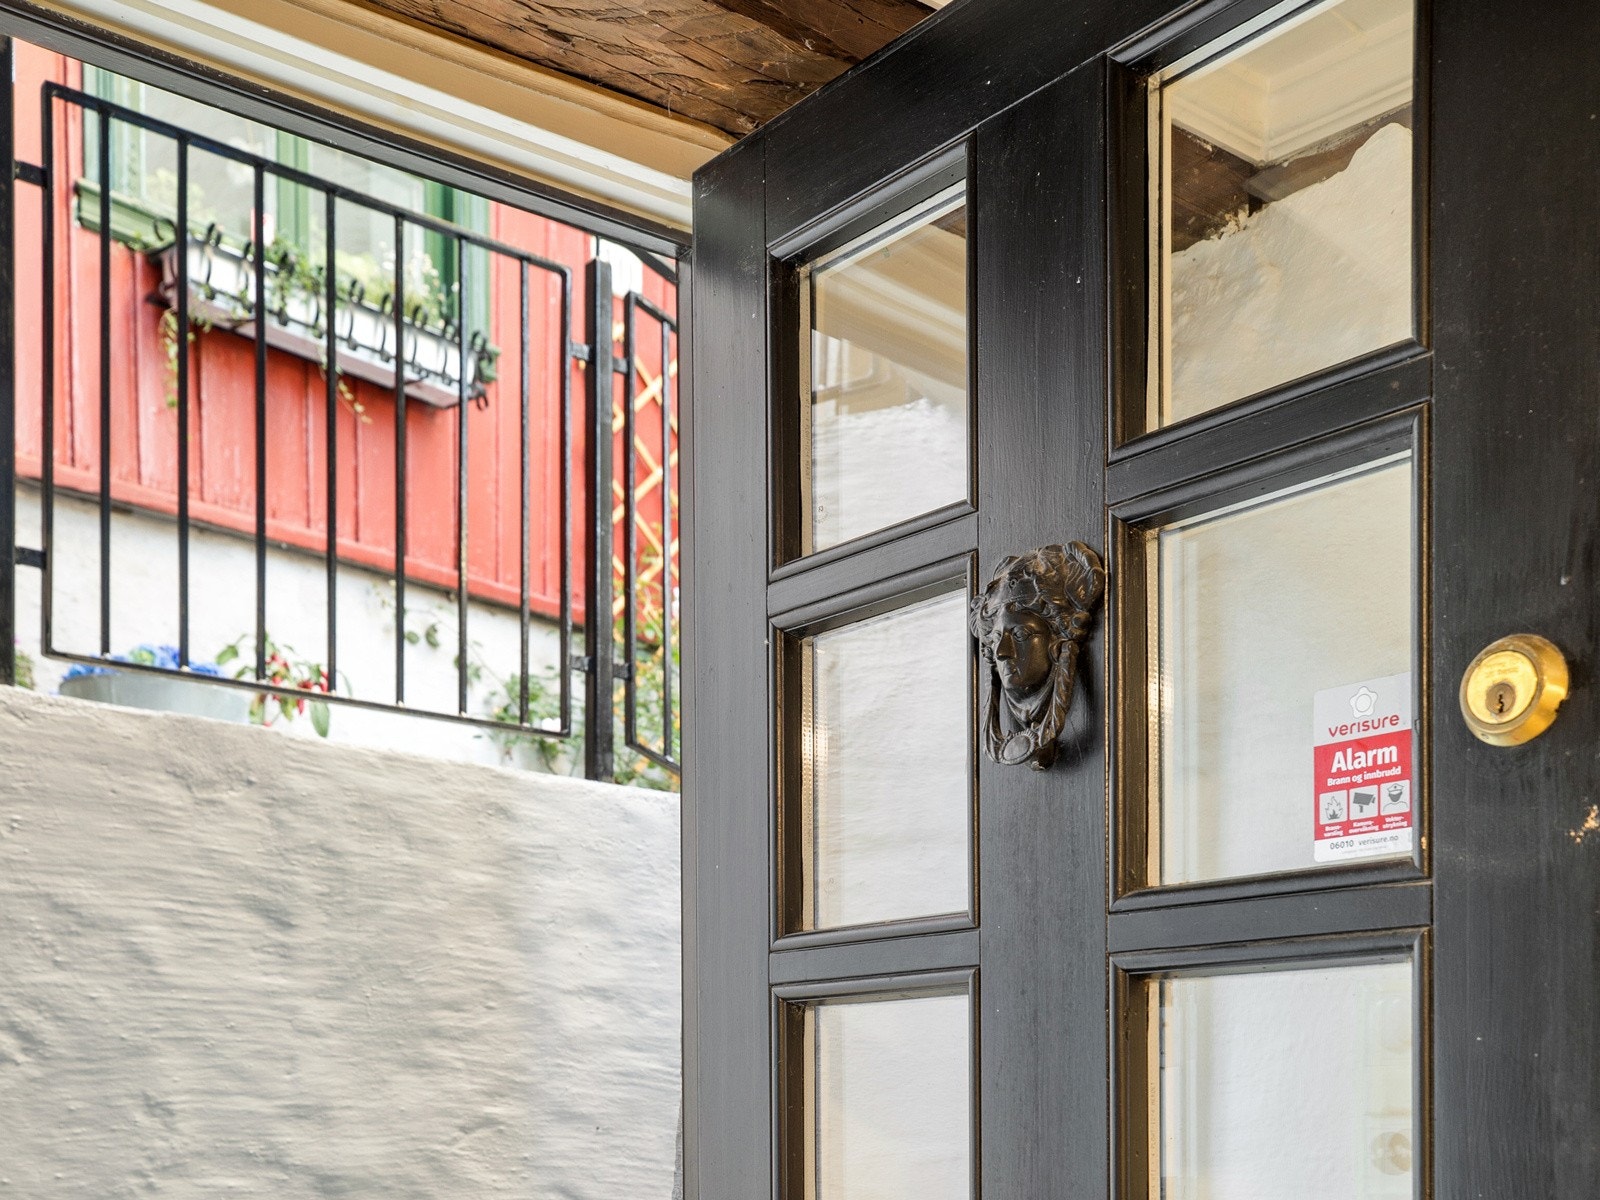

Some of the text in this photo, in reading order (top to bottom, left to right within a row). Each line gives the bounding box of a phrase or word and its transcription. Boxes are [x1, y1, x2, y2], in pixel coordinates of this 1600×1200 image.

[1328, 714, 1400, 737] verisure
[1331, 745, 1398, 773] Alarm
[1327, 765, 1402, 787] Brann og innbrudd
[1329, 840, 1354, 850] 06010
[1358, 836, 1399, 845] verisure.no
